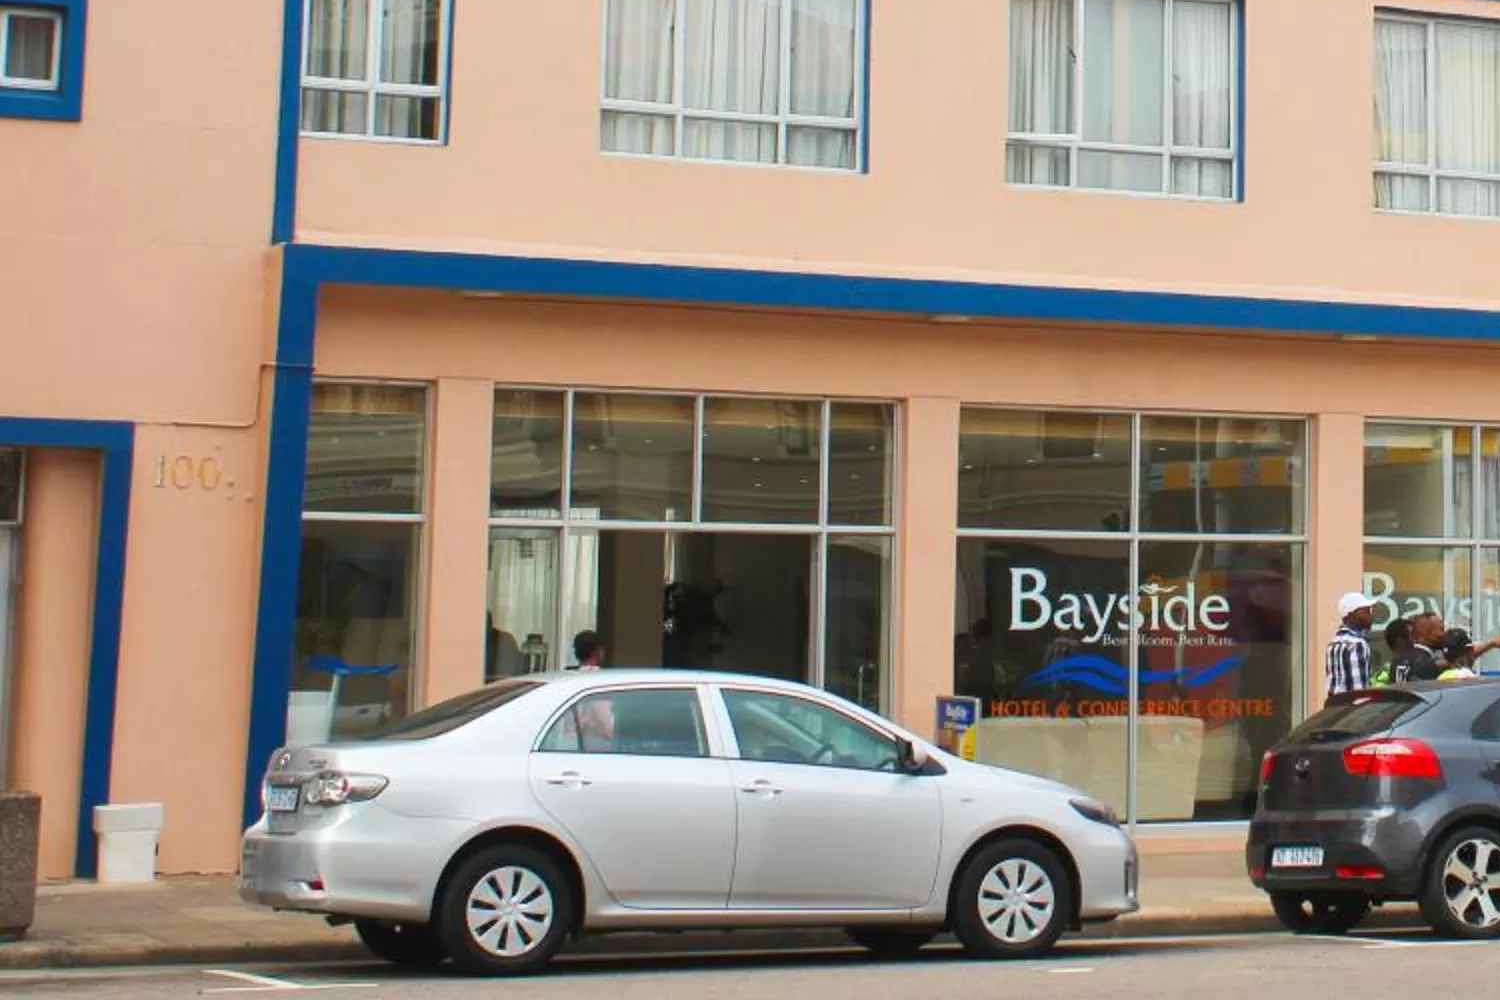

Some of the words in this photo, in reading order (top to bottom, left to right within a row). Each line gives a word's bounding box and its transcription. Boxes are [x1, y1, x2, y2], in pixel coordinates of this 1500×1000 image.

[1008, 566, 1231, 642] Bayside
[990, 699, 1050, 717] HOTEL
[1055, 701, 1070, 717] &
[1207, 698, 1274, 717] CENTRE
